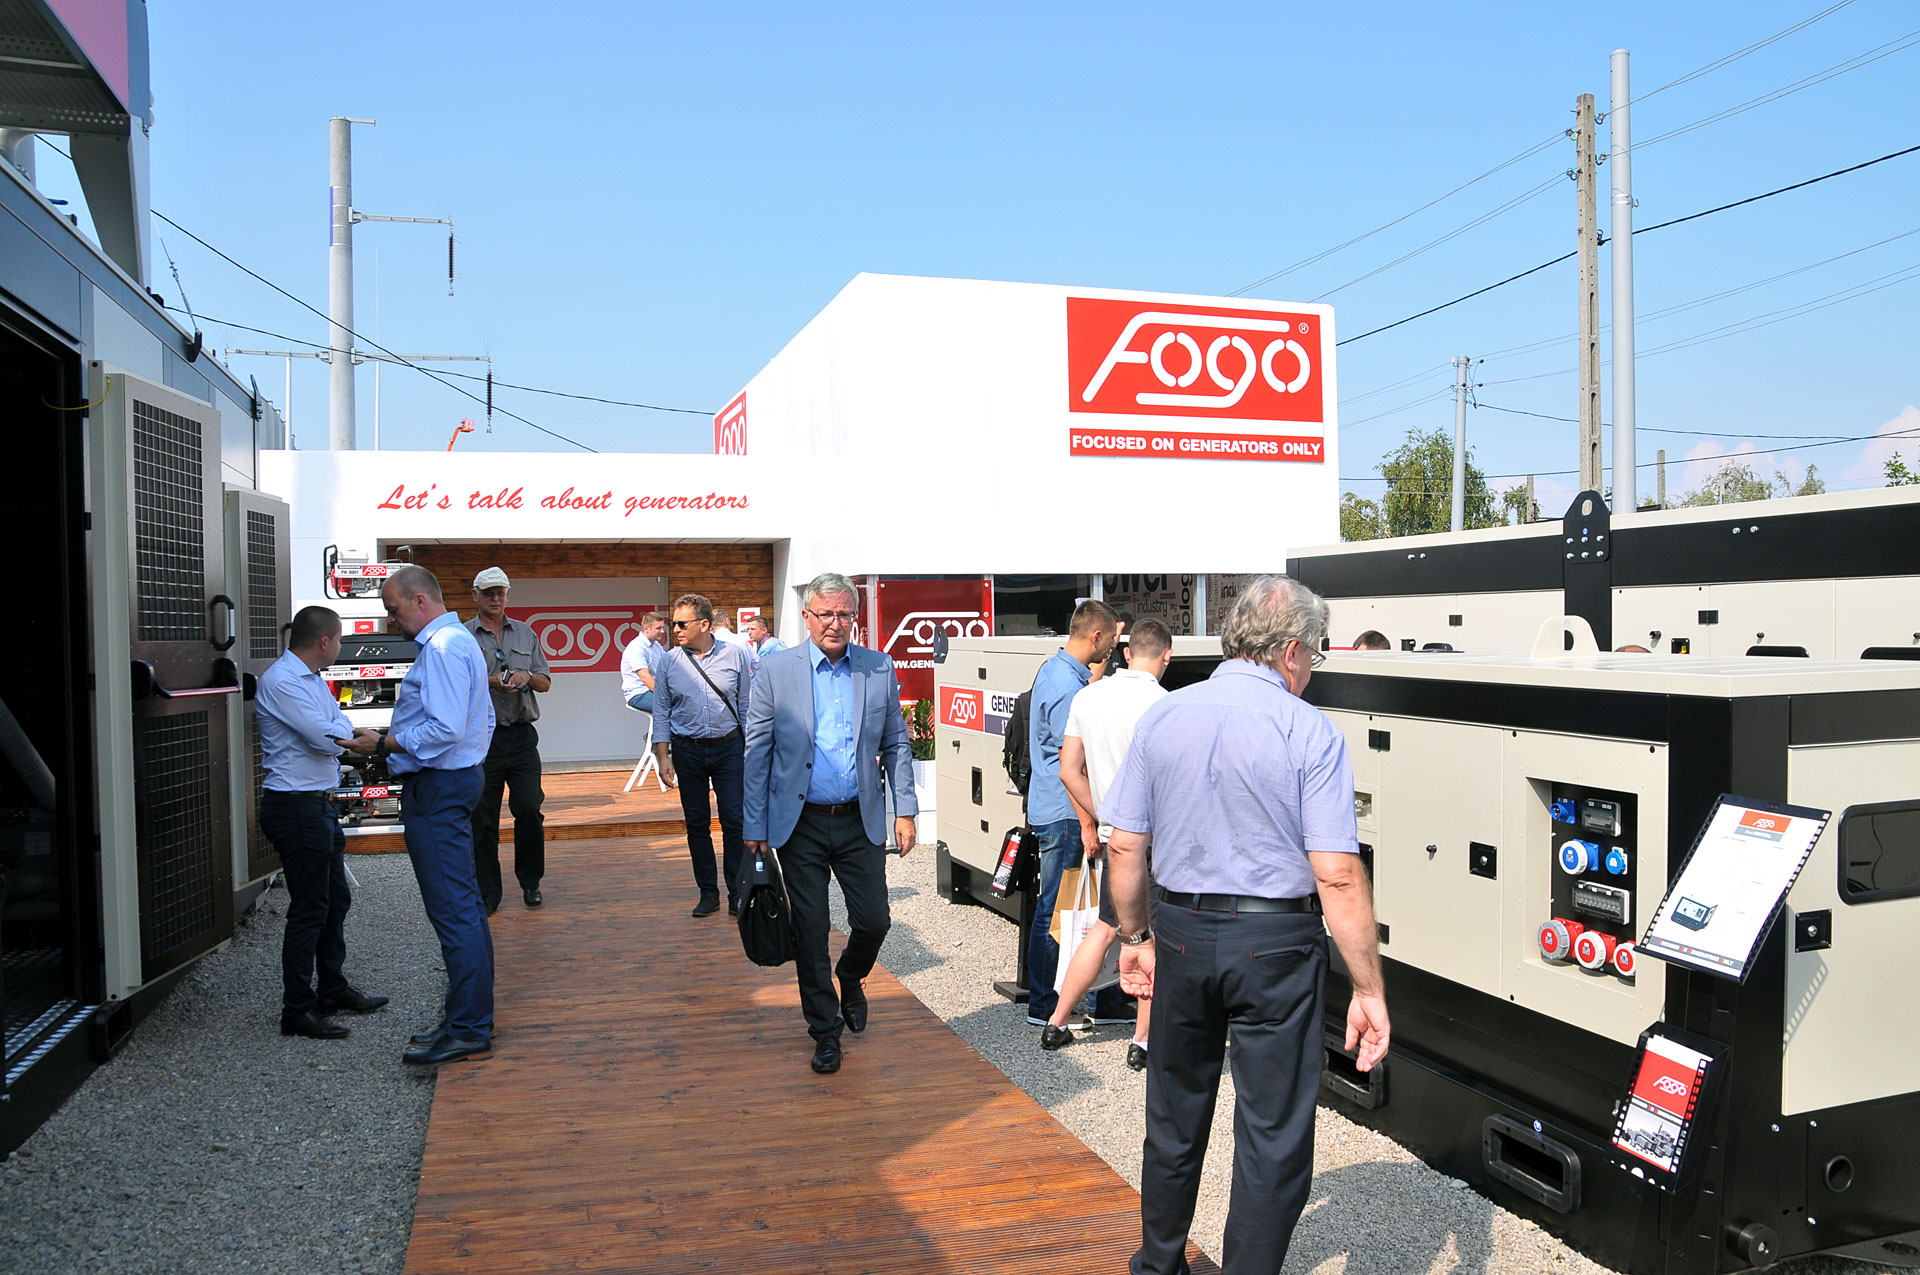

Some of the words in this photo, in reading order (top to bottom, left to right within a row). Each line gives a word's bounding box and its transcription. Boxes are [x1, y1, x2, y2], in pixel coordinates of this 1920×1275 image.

[1072, 435, 1147, 450] FOCUSED
[1151, 437, 1175, 451] ON
[1179, 438, 1279, 455] GENERATORS
[1282, 442, 1321, 456] ONLY
[377, 484, 451, 510] Let's
[468, 486, 524, 510] talk
[540, 486, 612, 510] about
[624, 491, 750, 517] generators
[1137, 599, 1167, 617] industry
